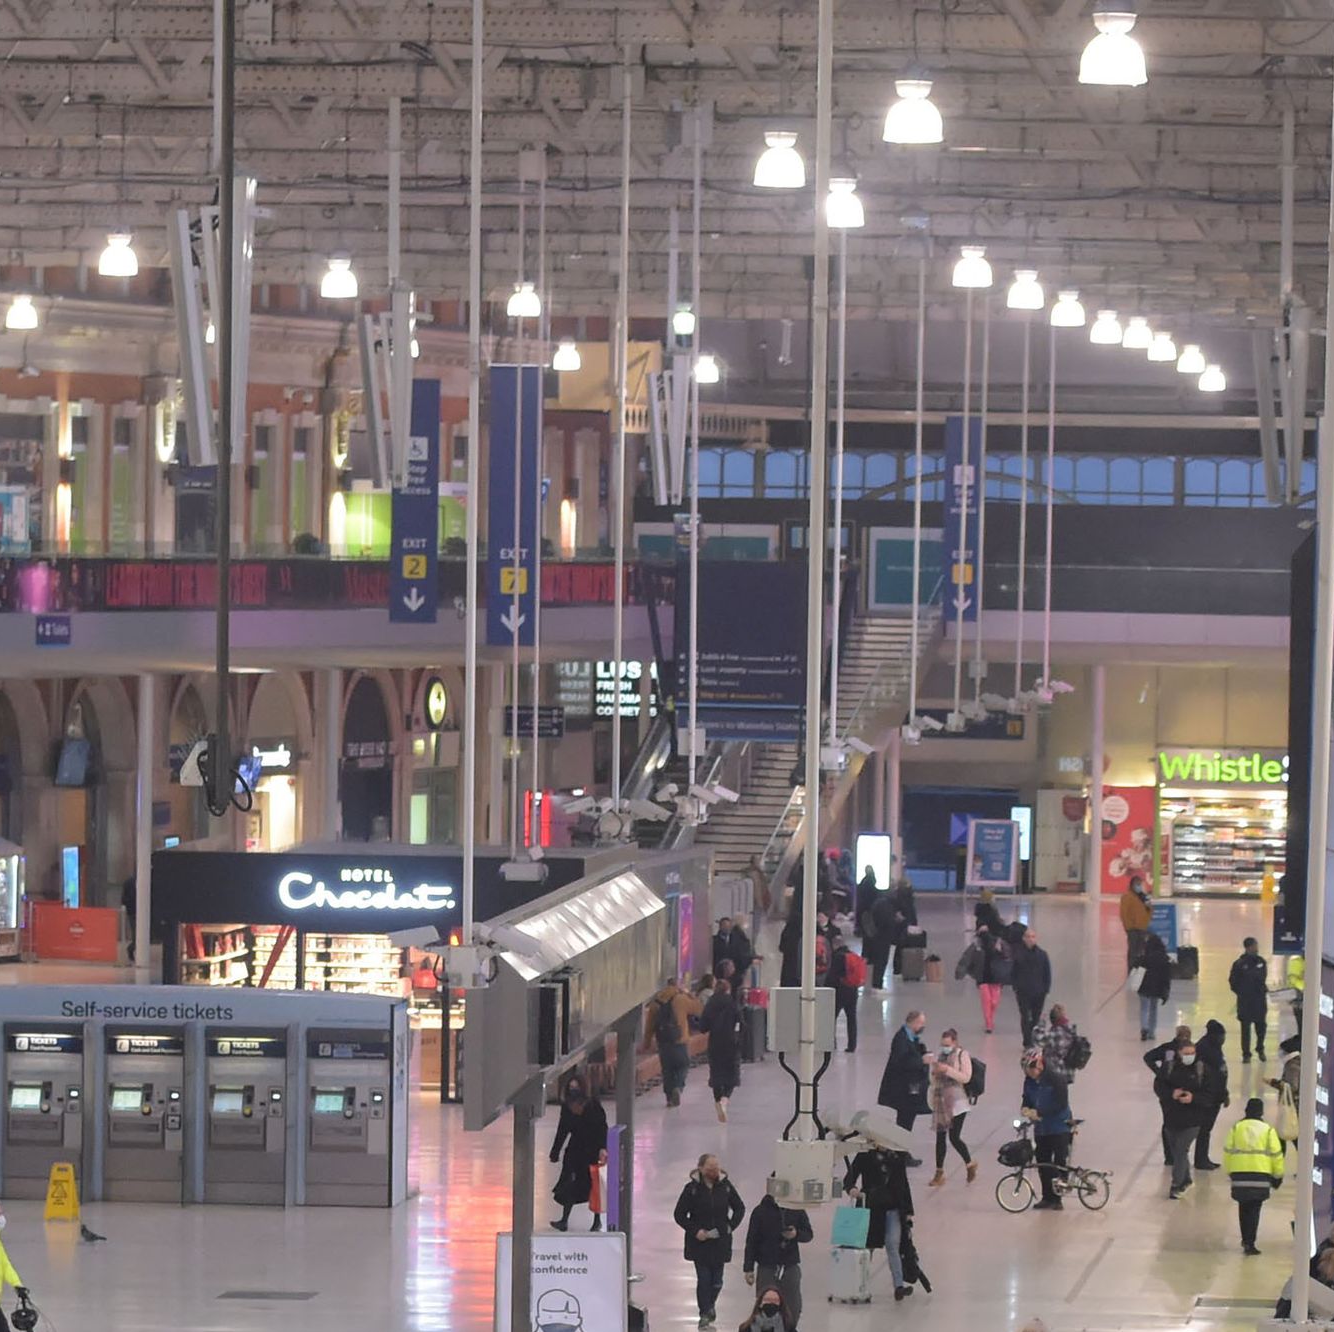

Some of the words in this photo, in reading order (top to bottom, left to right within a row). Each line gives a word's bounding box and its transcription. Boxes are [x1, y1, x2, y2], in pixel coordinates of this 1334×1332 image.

[402, 538, 427, 549] EXIT
[500, 548, 529, 560] EXT
[408, 557, 420, 577] 2
[340, 868, 394, 883] HOTEL
[61, 1000, 168, 1019] Self-service
[174, 1001, 233, 1020] tickets
[131, 1039, 158, 1048] TICKETS
[232, 1041, 259, 1049] TICKETS
[564, 1251, 588, 1262] with
